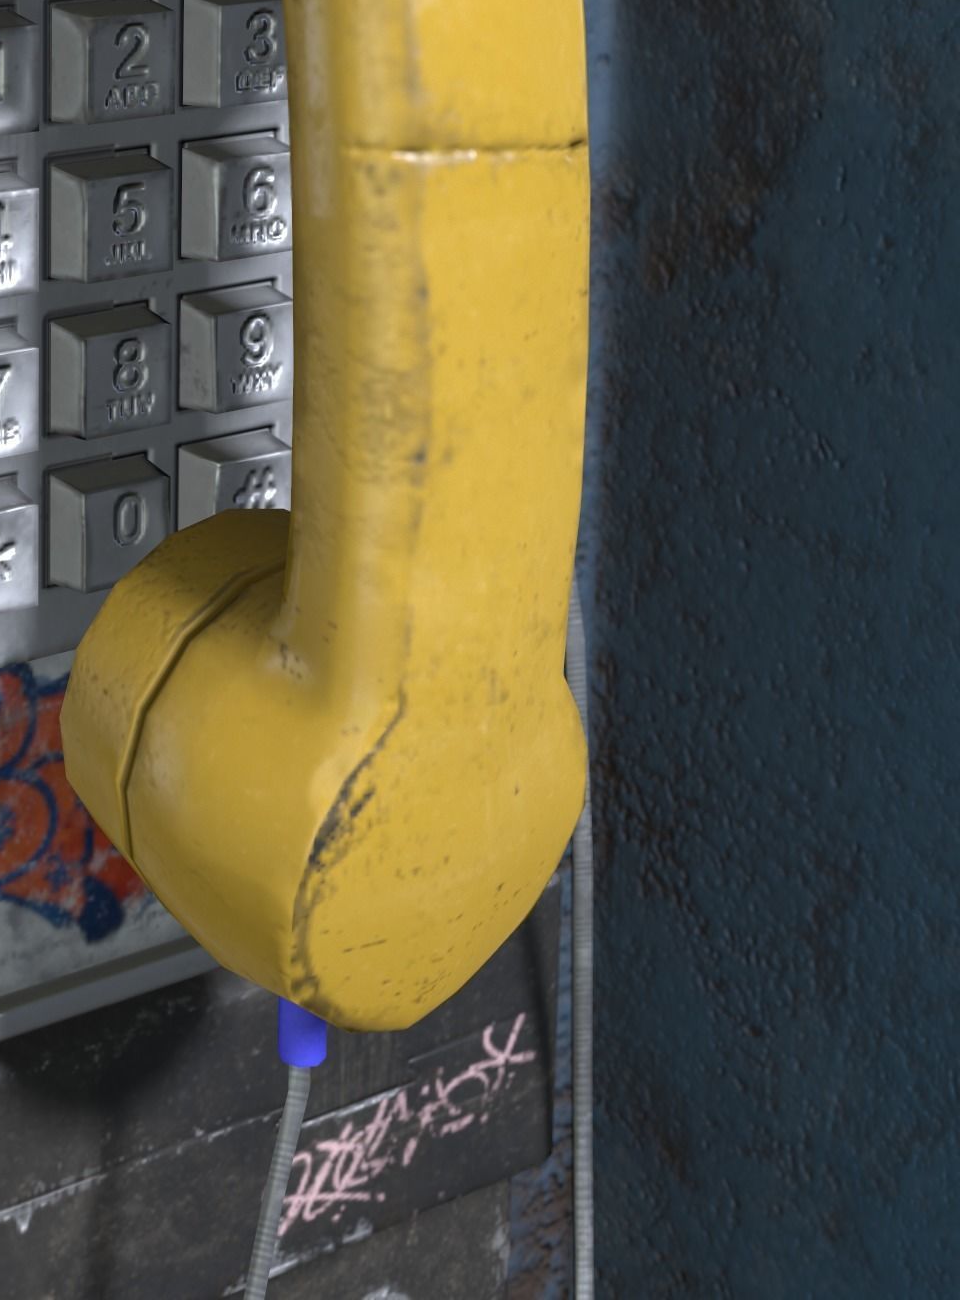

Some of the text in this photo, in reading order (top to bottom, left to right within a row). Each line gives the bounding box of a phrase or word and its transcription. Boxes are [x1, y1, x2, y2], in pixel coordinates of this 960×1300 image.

[114, 22, 150, 82] 2
[244, 8, 279, 66] 3
[112, 182, 148, 238] 5
[243, 165, 278, 220] 6
[112, 337, 149, 393] 8
[240, 312, 275, 369] 9
[113, 491, 147, 549] 0
